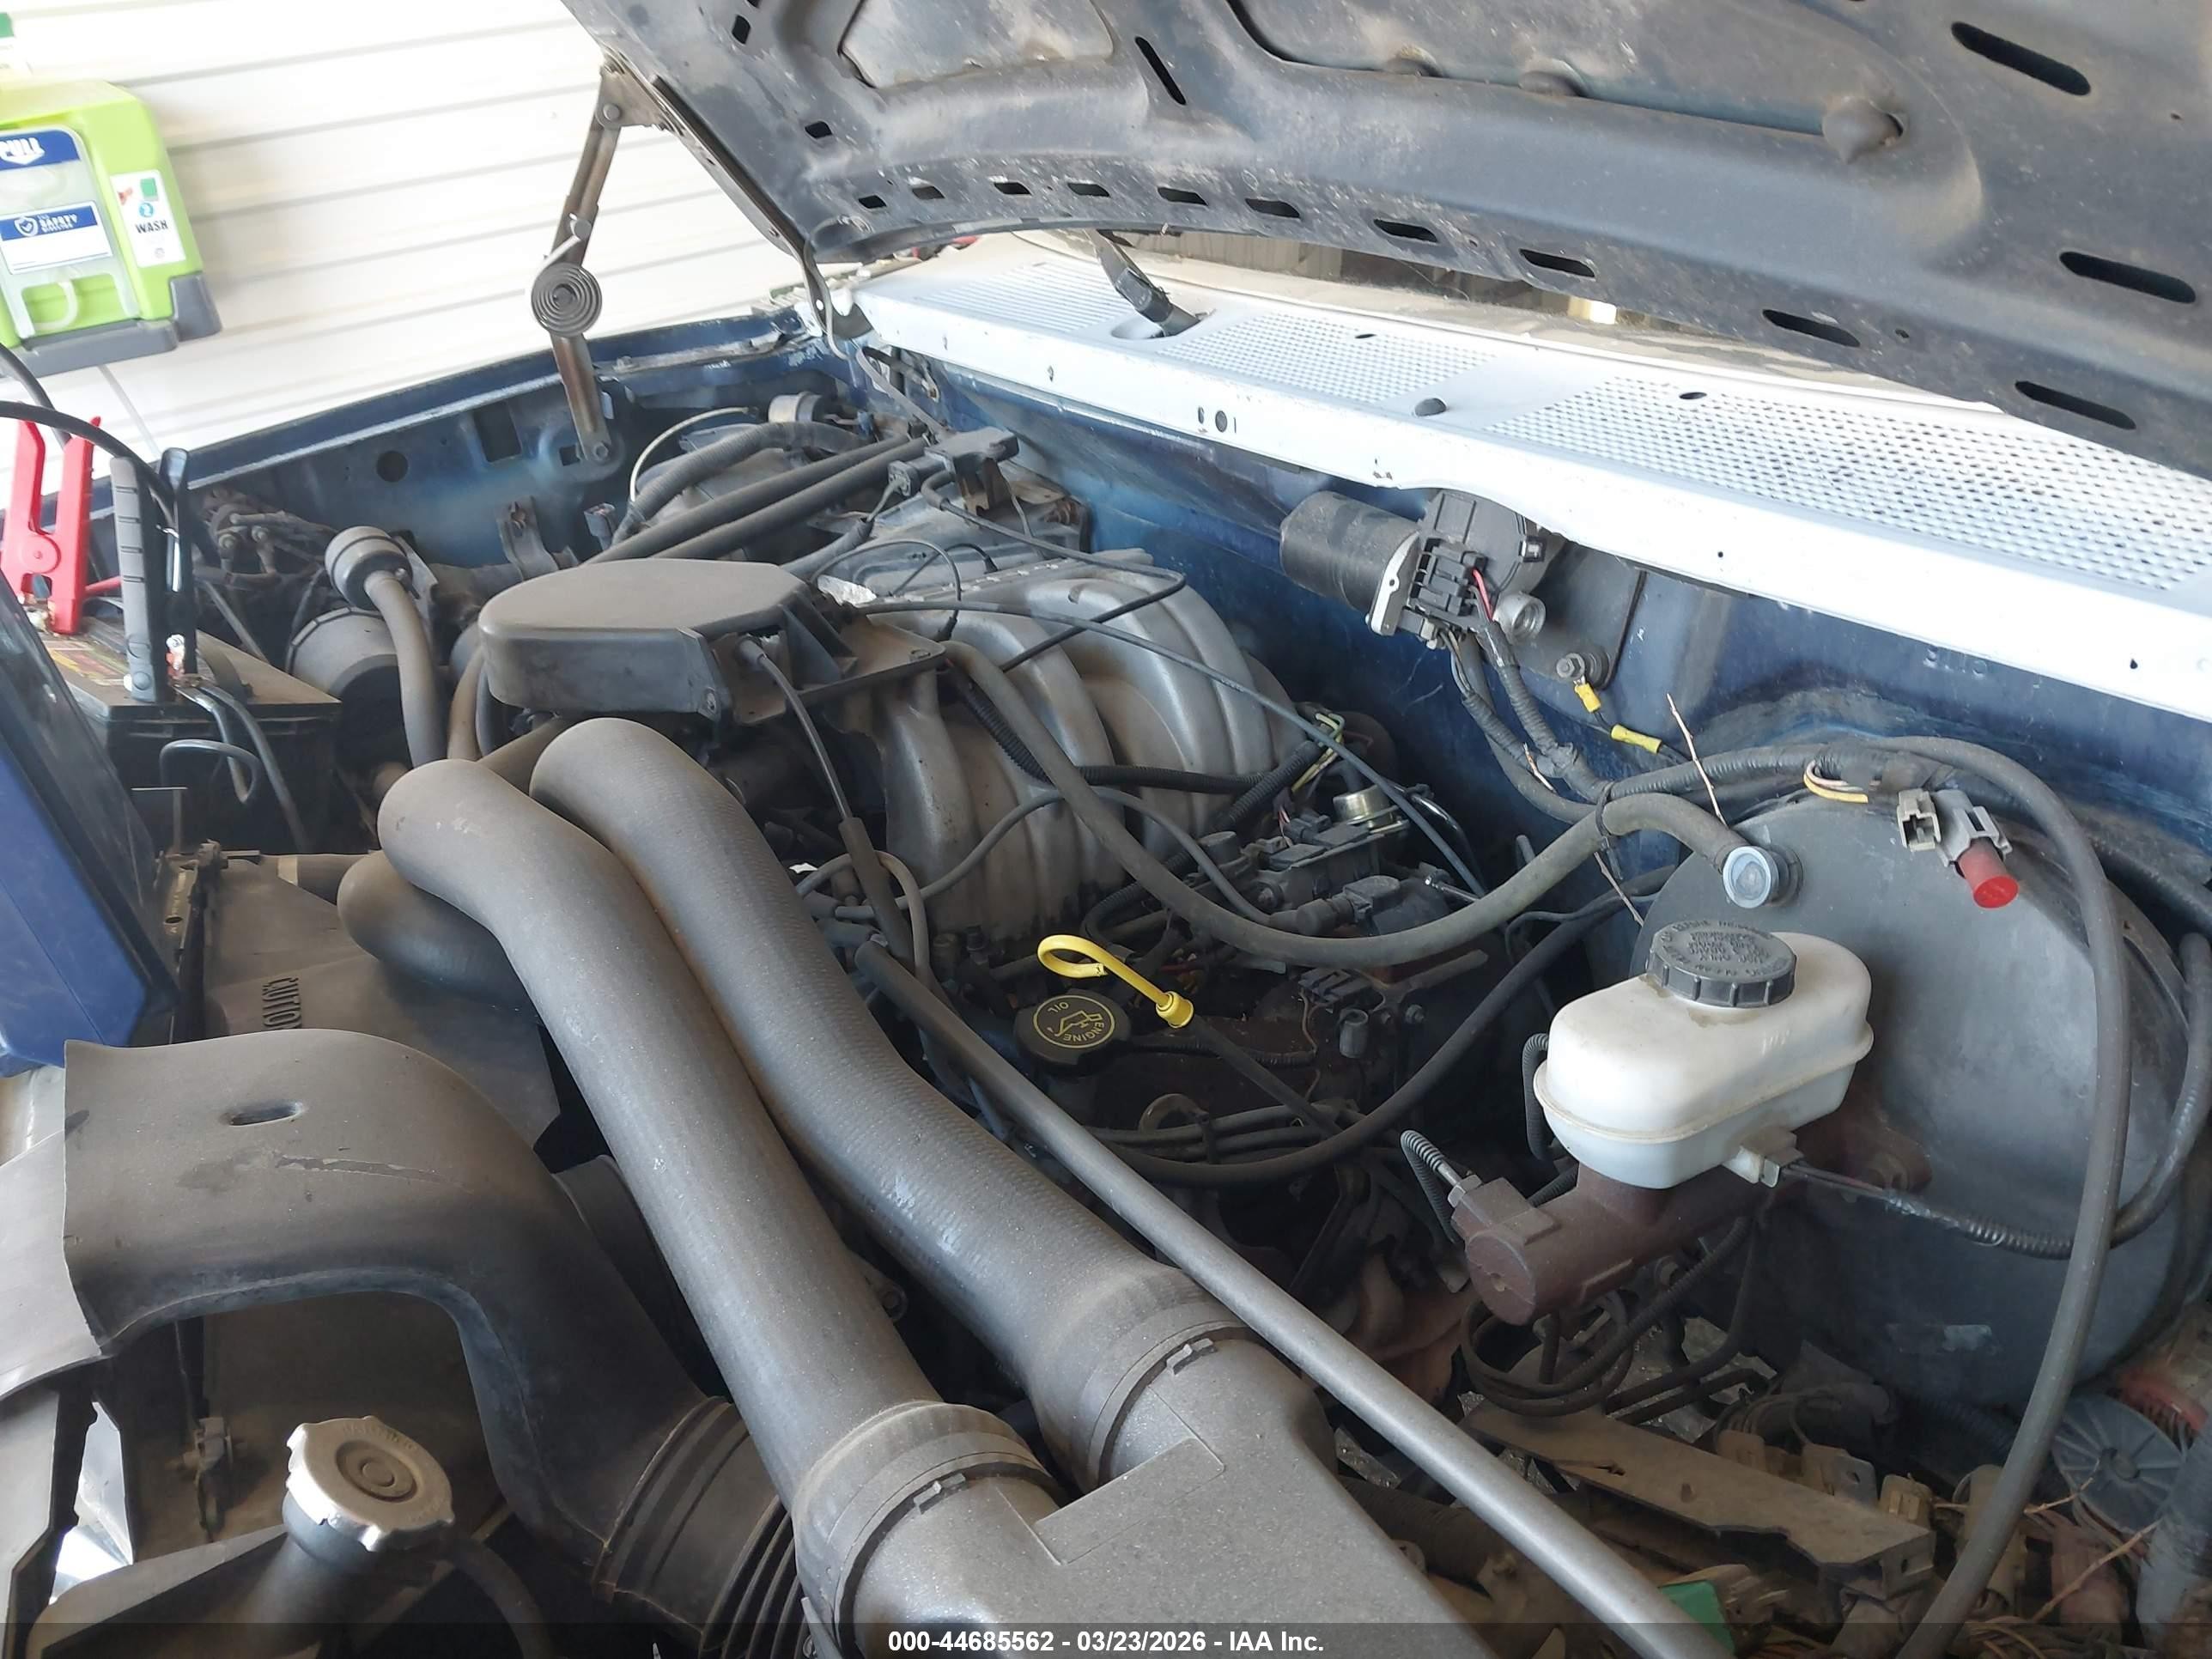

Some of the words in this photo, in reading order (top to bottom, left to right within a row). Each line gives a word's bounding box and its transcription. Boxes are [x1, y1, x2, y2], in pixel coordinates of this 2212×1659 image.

[135, 219, 168, 234] WASH
[1047, 1001, 1069, 1012] OIL
[1063, 1022, 1105, 1042] ENGINE
